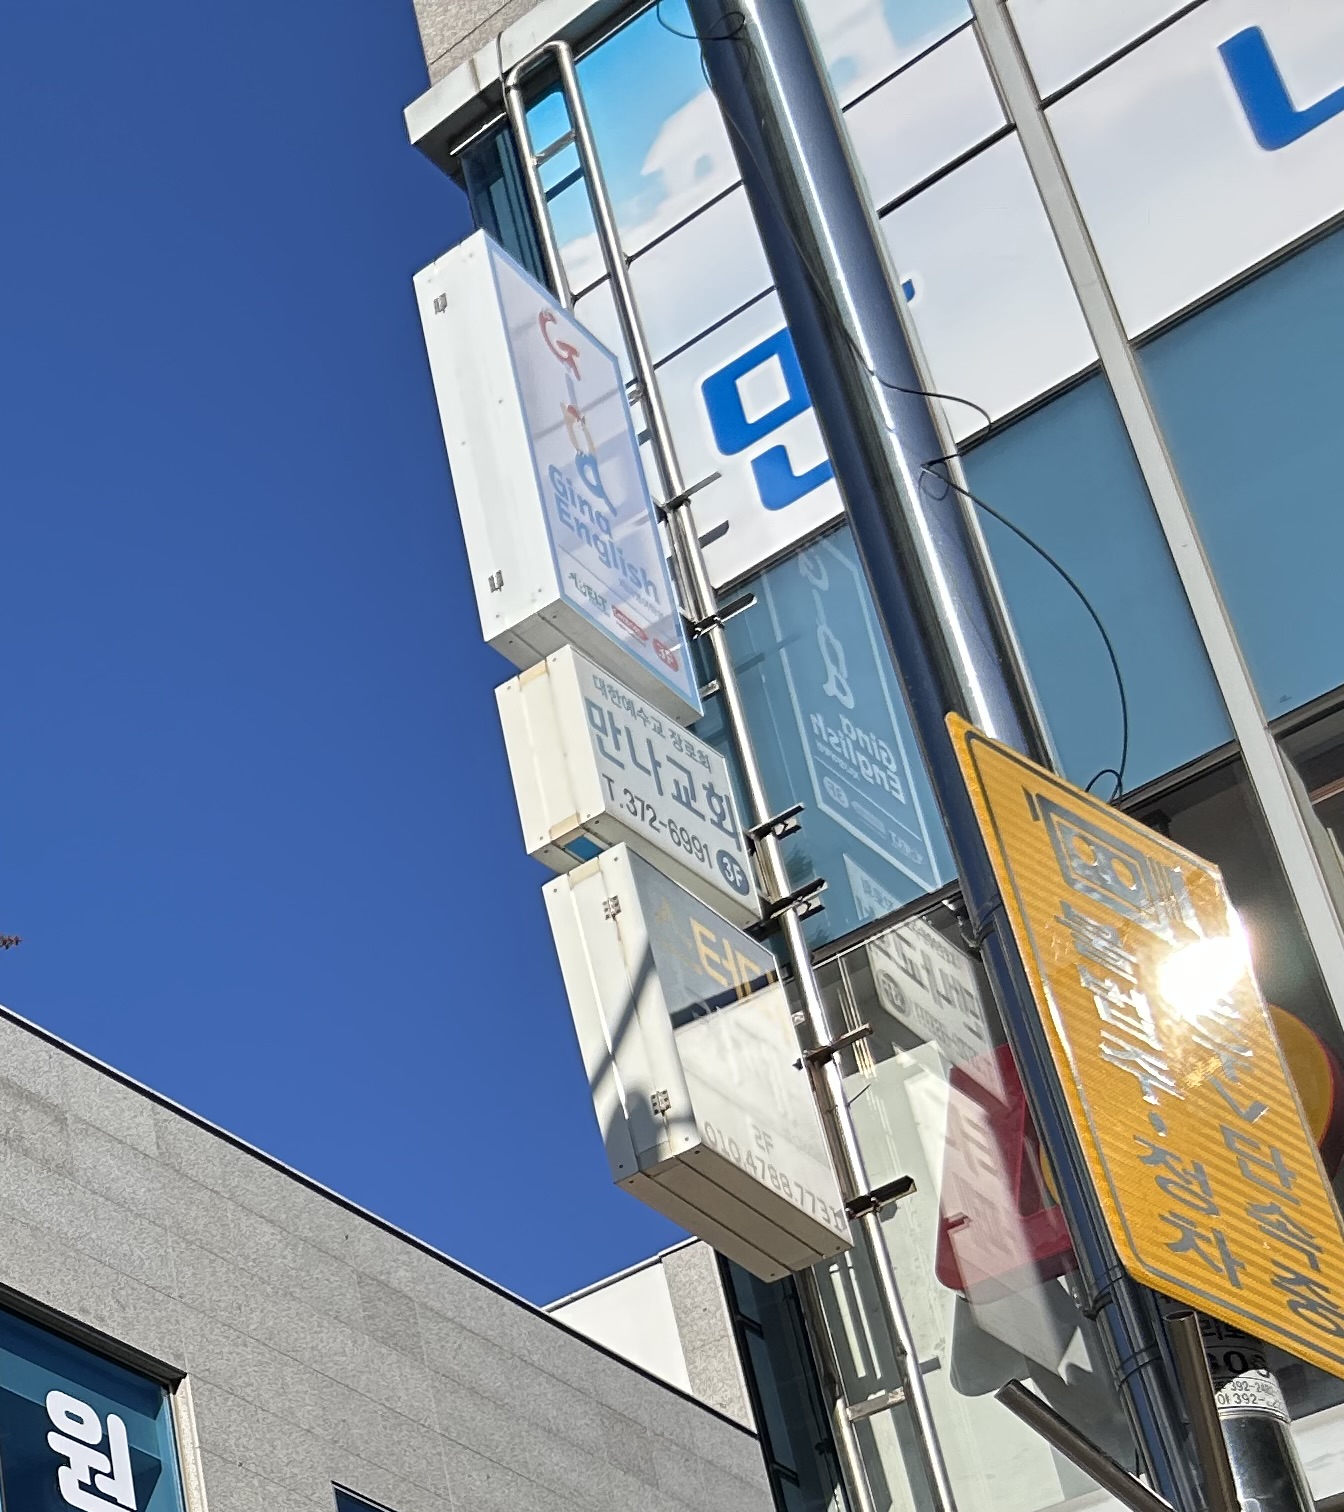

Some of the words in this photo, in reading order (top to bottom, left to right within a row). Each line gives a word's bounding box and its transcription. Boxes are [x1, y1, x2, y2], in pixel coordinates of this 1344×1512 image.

[549, 464, 612, 537] Gina
[555, 491, 660, 605] English
[584, 696, 743, 852] 만나교회
[592, 674, 666, 740] 대한예수교
[668, 728, 712, 775] 장로회
[722, 857, 744, 888] 3F
